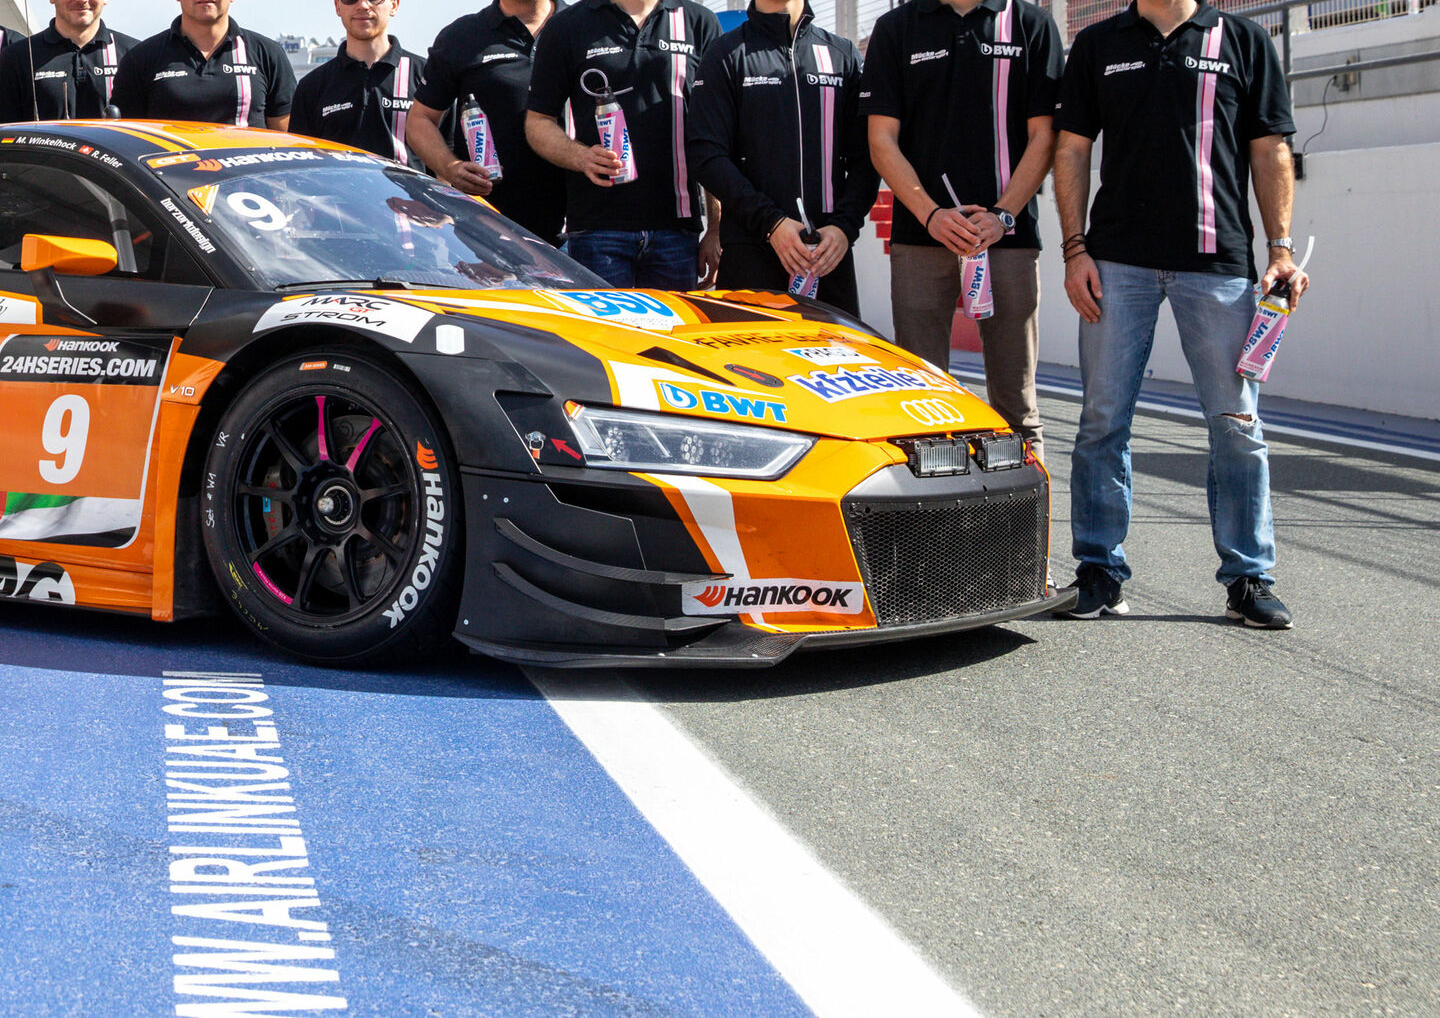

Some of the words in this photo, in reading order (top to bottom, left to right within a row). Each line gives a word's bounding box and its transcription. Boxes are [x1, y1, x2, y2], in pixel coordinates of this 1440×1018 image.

[670, 42, 695, 55] BWT
[993, 45, 1023, 58] BWT
[233, 65, 258, 75] BWT
[1198, 59, 1230, 73] BWT
[818, 75, 844, 87] BWT
[475, 131, 485, 154] BWT
[603, 132, 611, 149] WT
[16, 136, 26, 144] M.
[28, 136, 77, 150] Winkelhock
[90, 150, 100, 159] R.
[99, 153, 123, 169] Feller
[226, 192, 286, 231] 9
[792, 275, 805, 290] BW
[971, 265, 984, 290] BWT
[301, 296, 391, 311] MARC
[349, 306, 376, 314] GT
[559, 292, 674, 317] BSU
[280, 311, 387, 327] STROM
[1262, 309, 1278, 319] BWT
[1249, 322, 1268, 346] BWT
[0, 355, 157, 378] 24HSERIES.COM
[794, 367, 965, 400] kfzteile24
[700, 390, 787, 422] BWT
[38, 394, 91, 484] 9
[216, 431, 230, 448] VR
